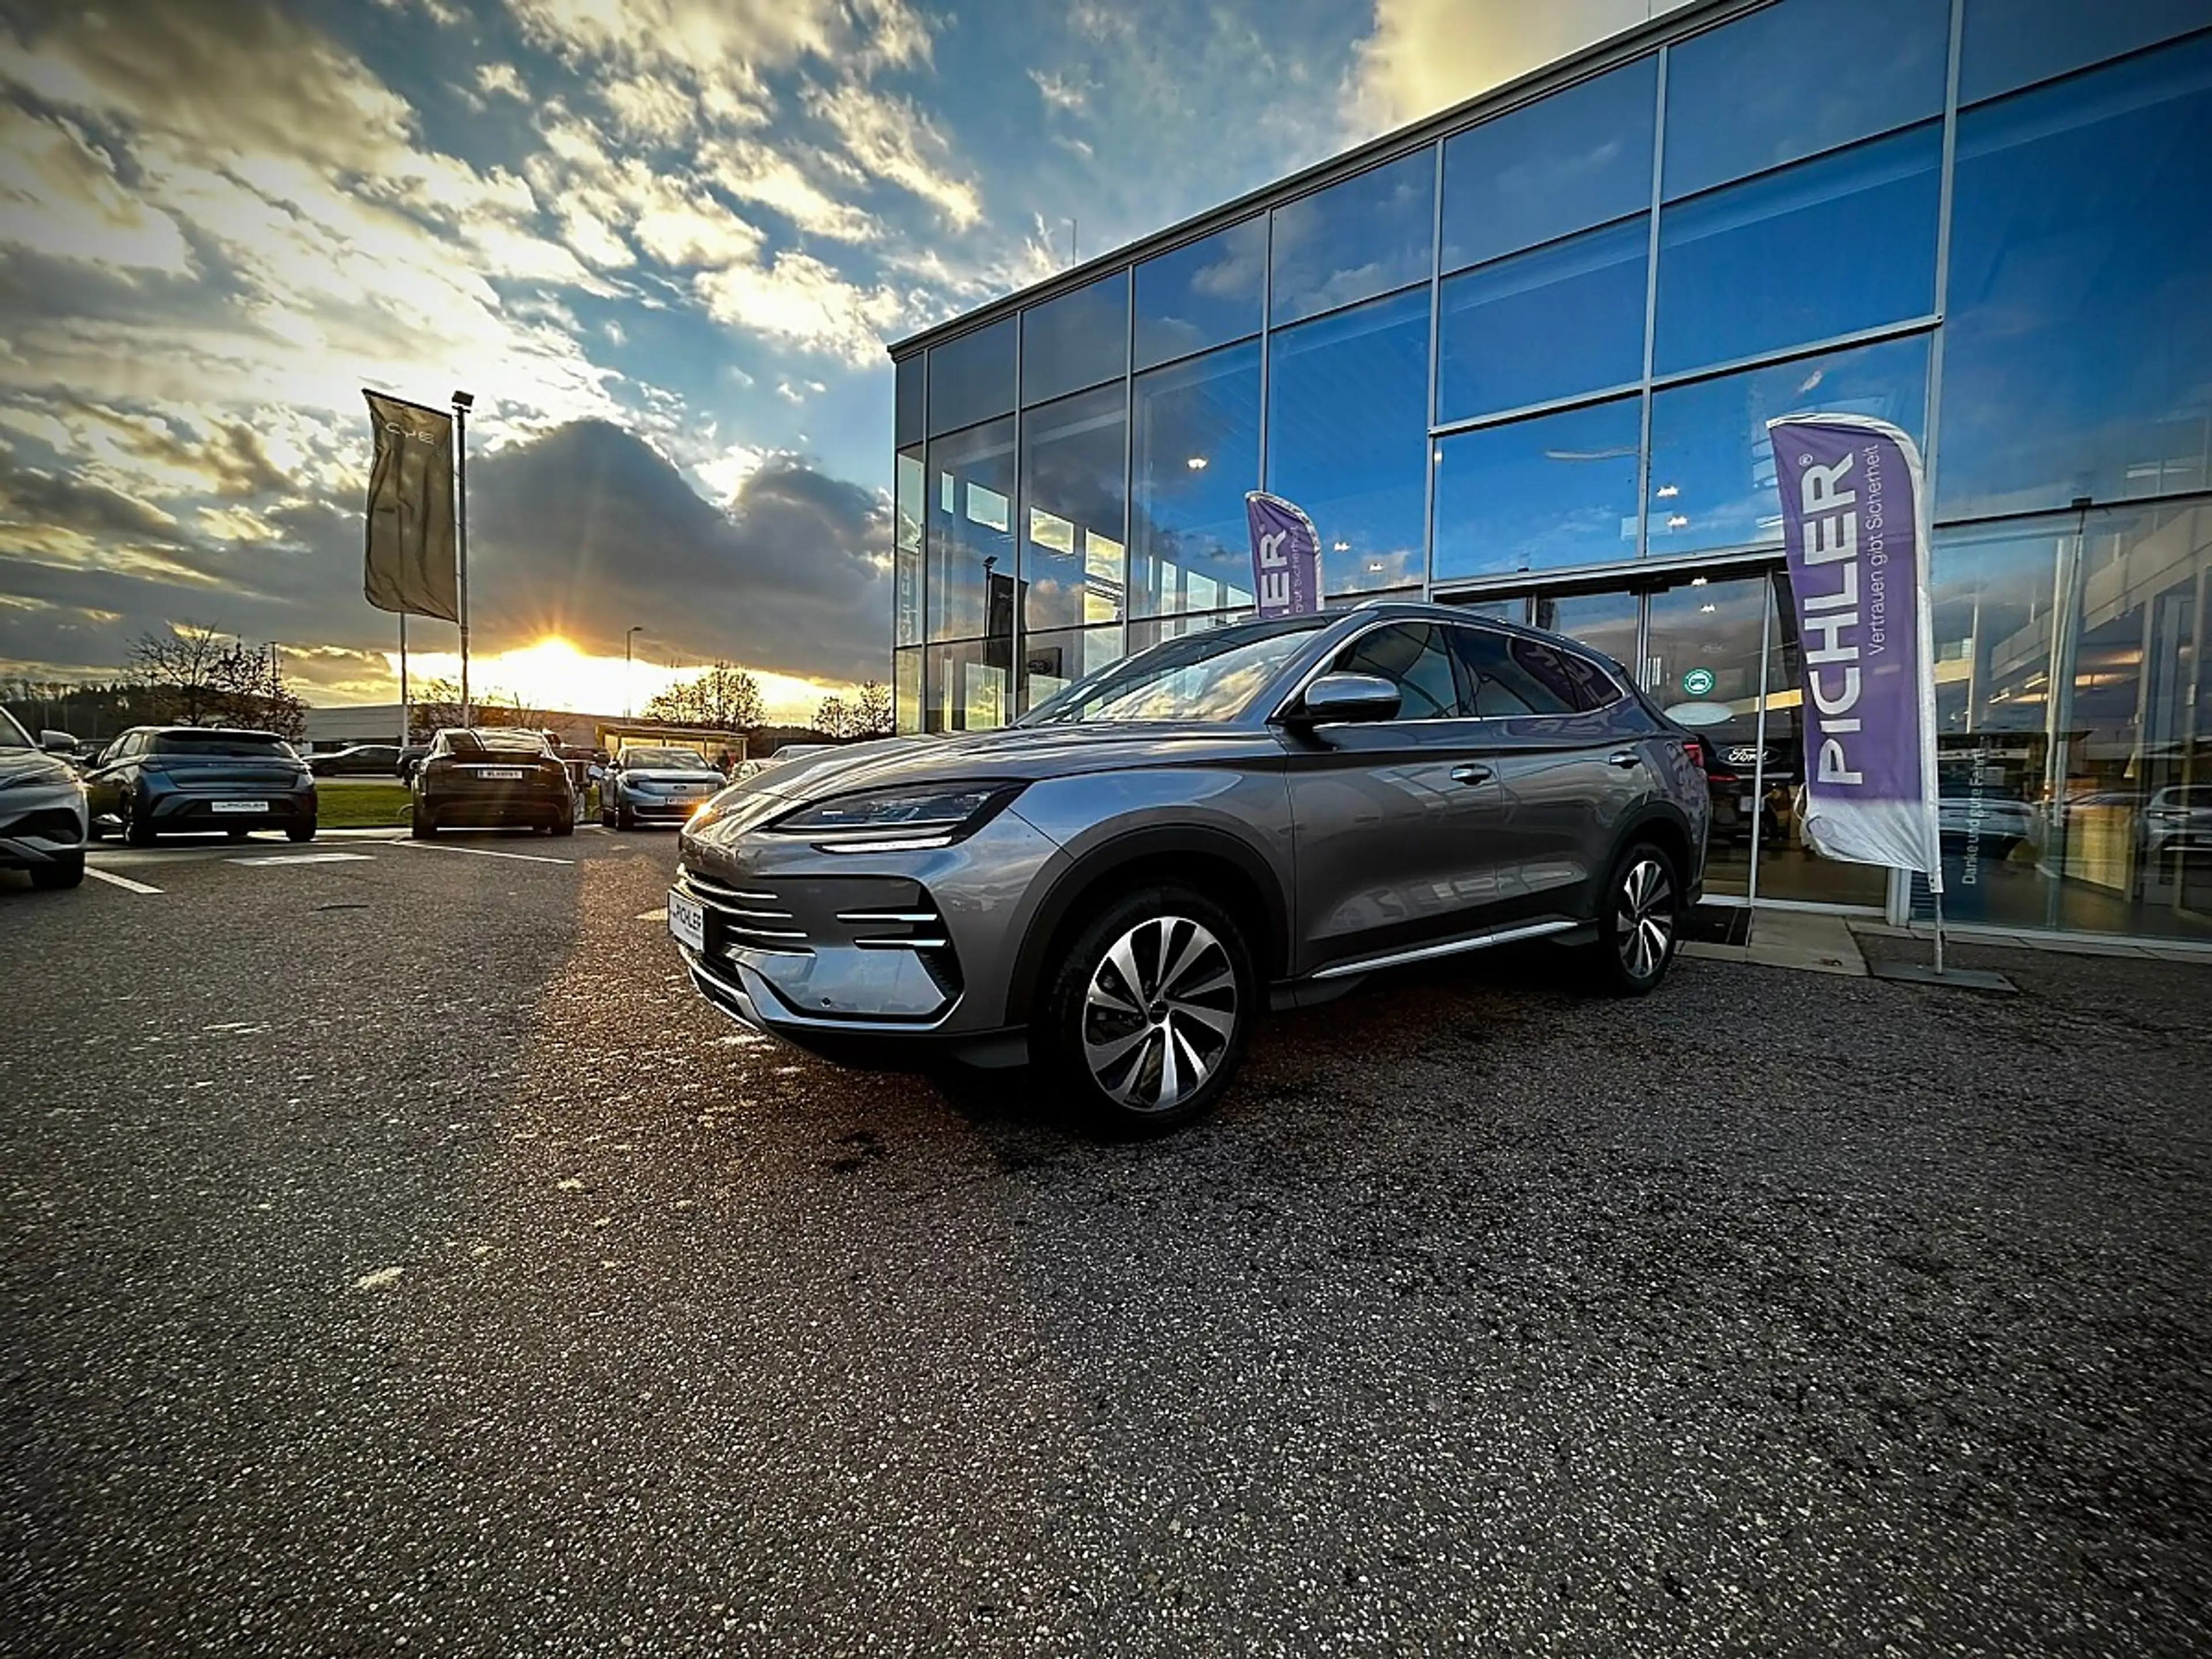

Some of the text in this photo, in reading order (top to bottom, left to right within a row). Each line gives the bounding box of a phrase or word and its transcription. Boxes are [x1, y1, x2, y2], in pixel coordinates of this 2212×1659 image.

[1862, 444, 1888, 656] Vertrauen gibt Sicherheit
[1965, 819, 1980, 843] und
[1961, 845, 1979, 885] Danke
